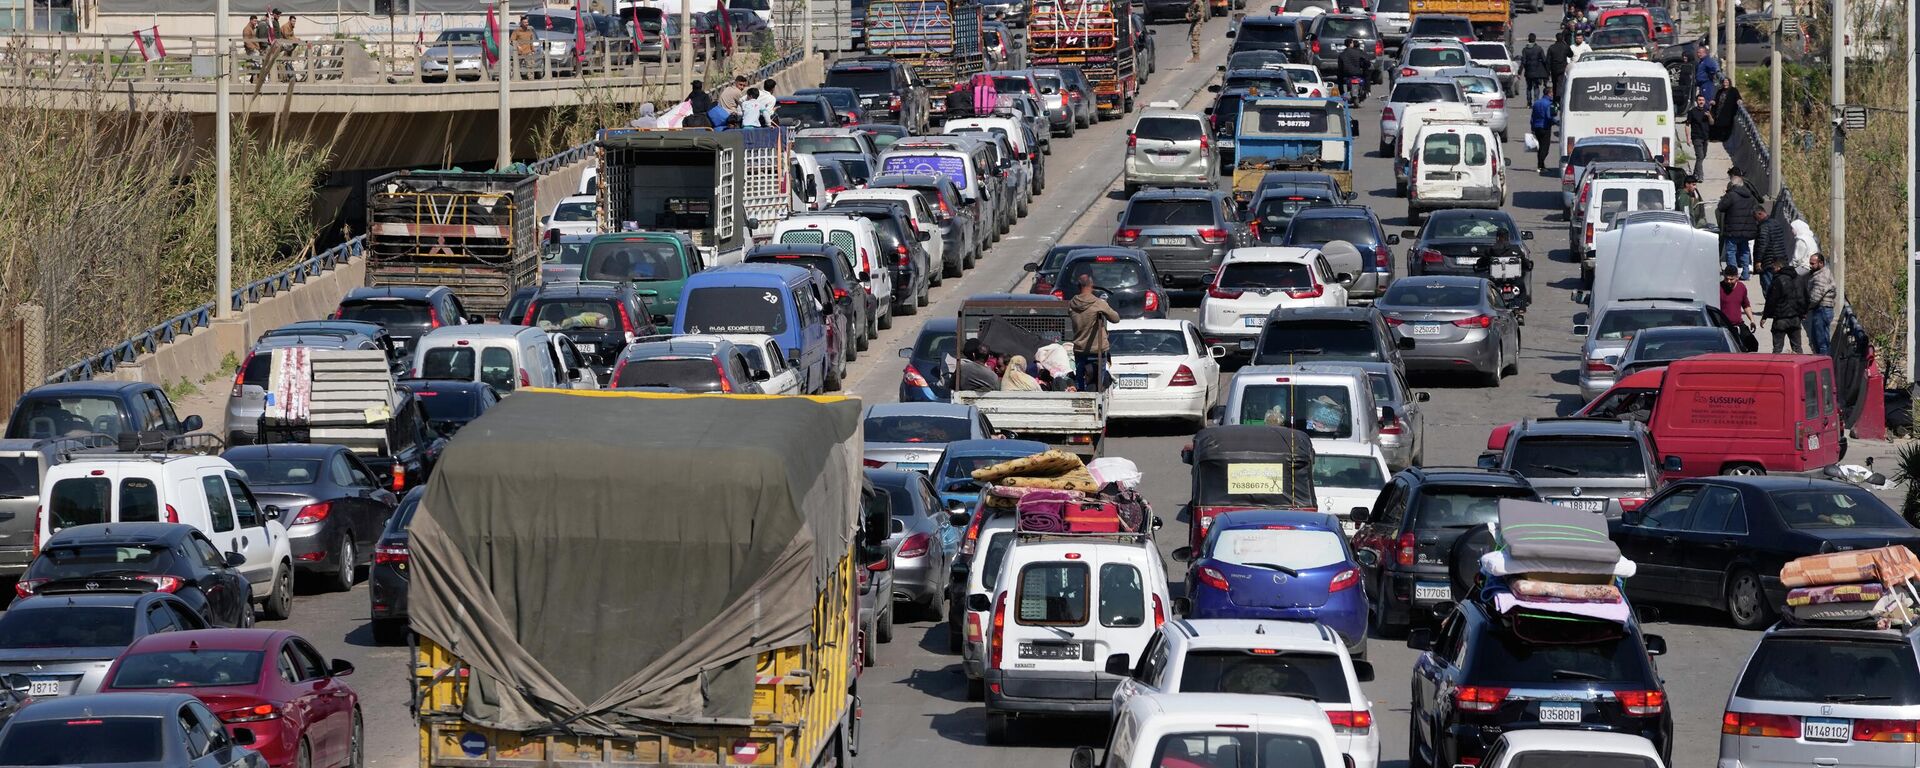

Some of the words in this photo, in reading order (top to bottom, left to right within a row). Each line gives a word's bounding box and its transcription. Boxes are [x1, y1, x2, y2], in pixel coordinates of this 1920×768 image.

[1587, 82, 1612, 93] مراد
[1614, 82, 1651, 93] نقليا
[1595, 127, 1643, 135] NISSAN
[763, 292, 778, 304] 29
[1807, 725, 1848, 738] N148102
